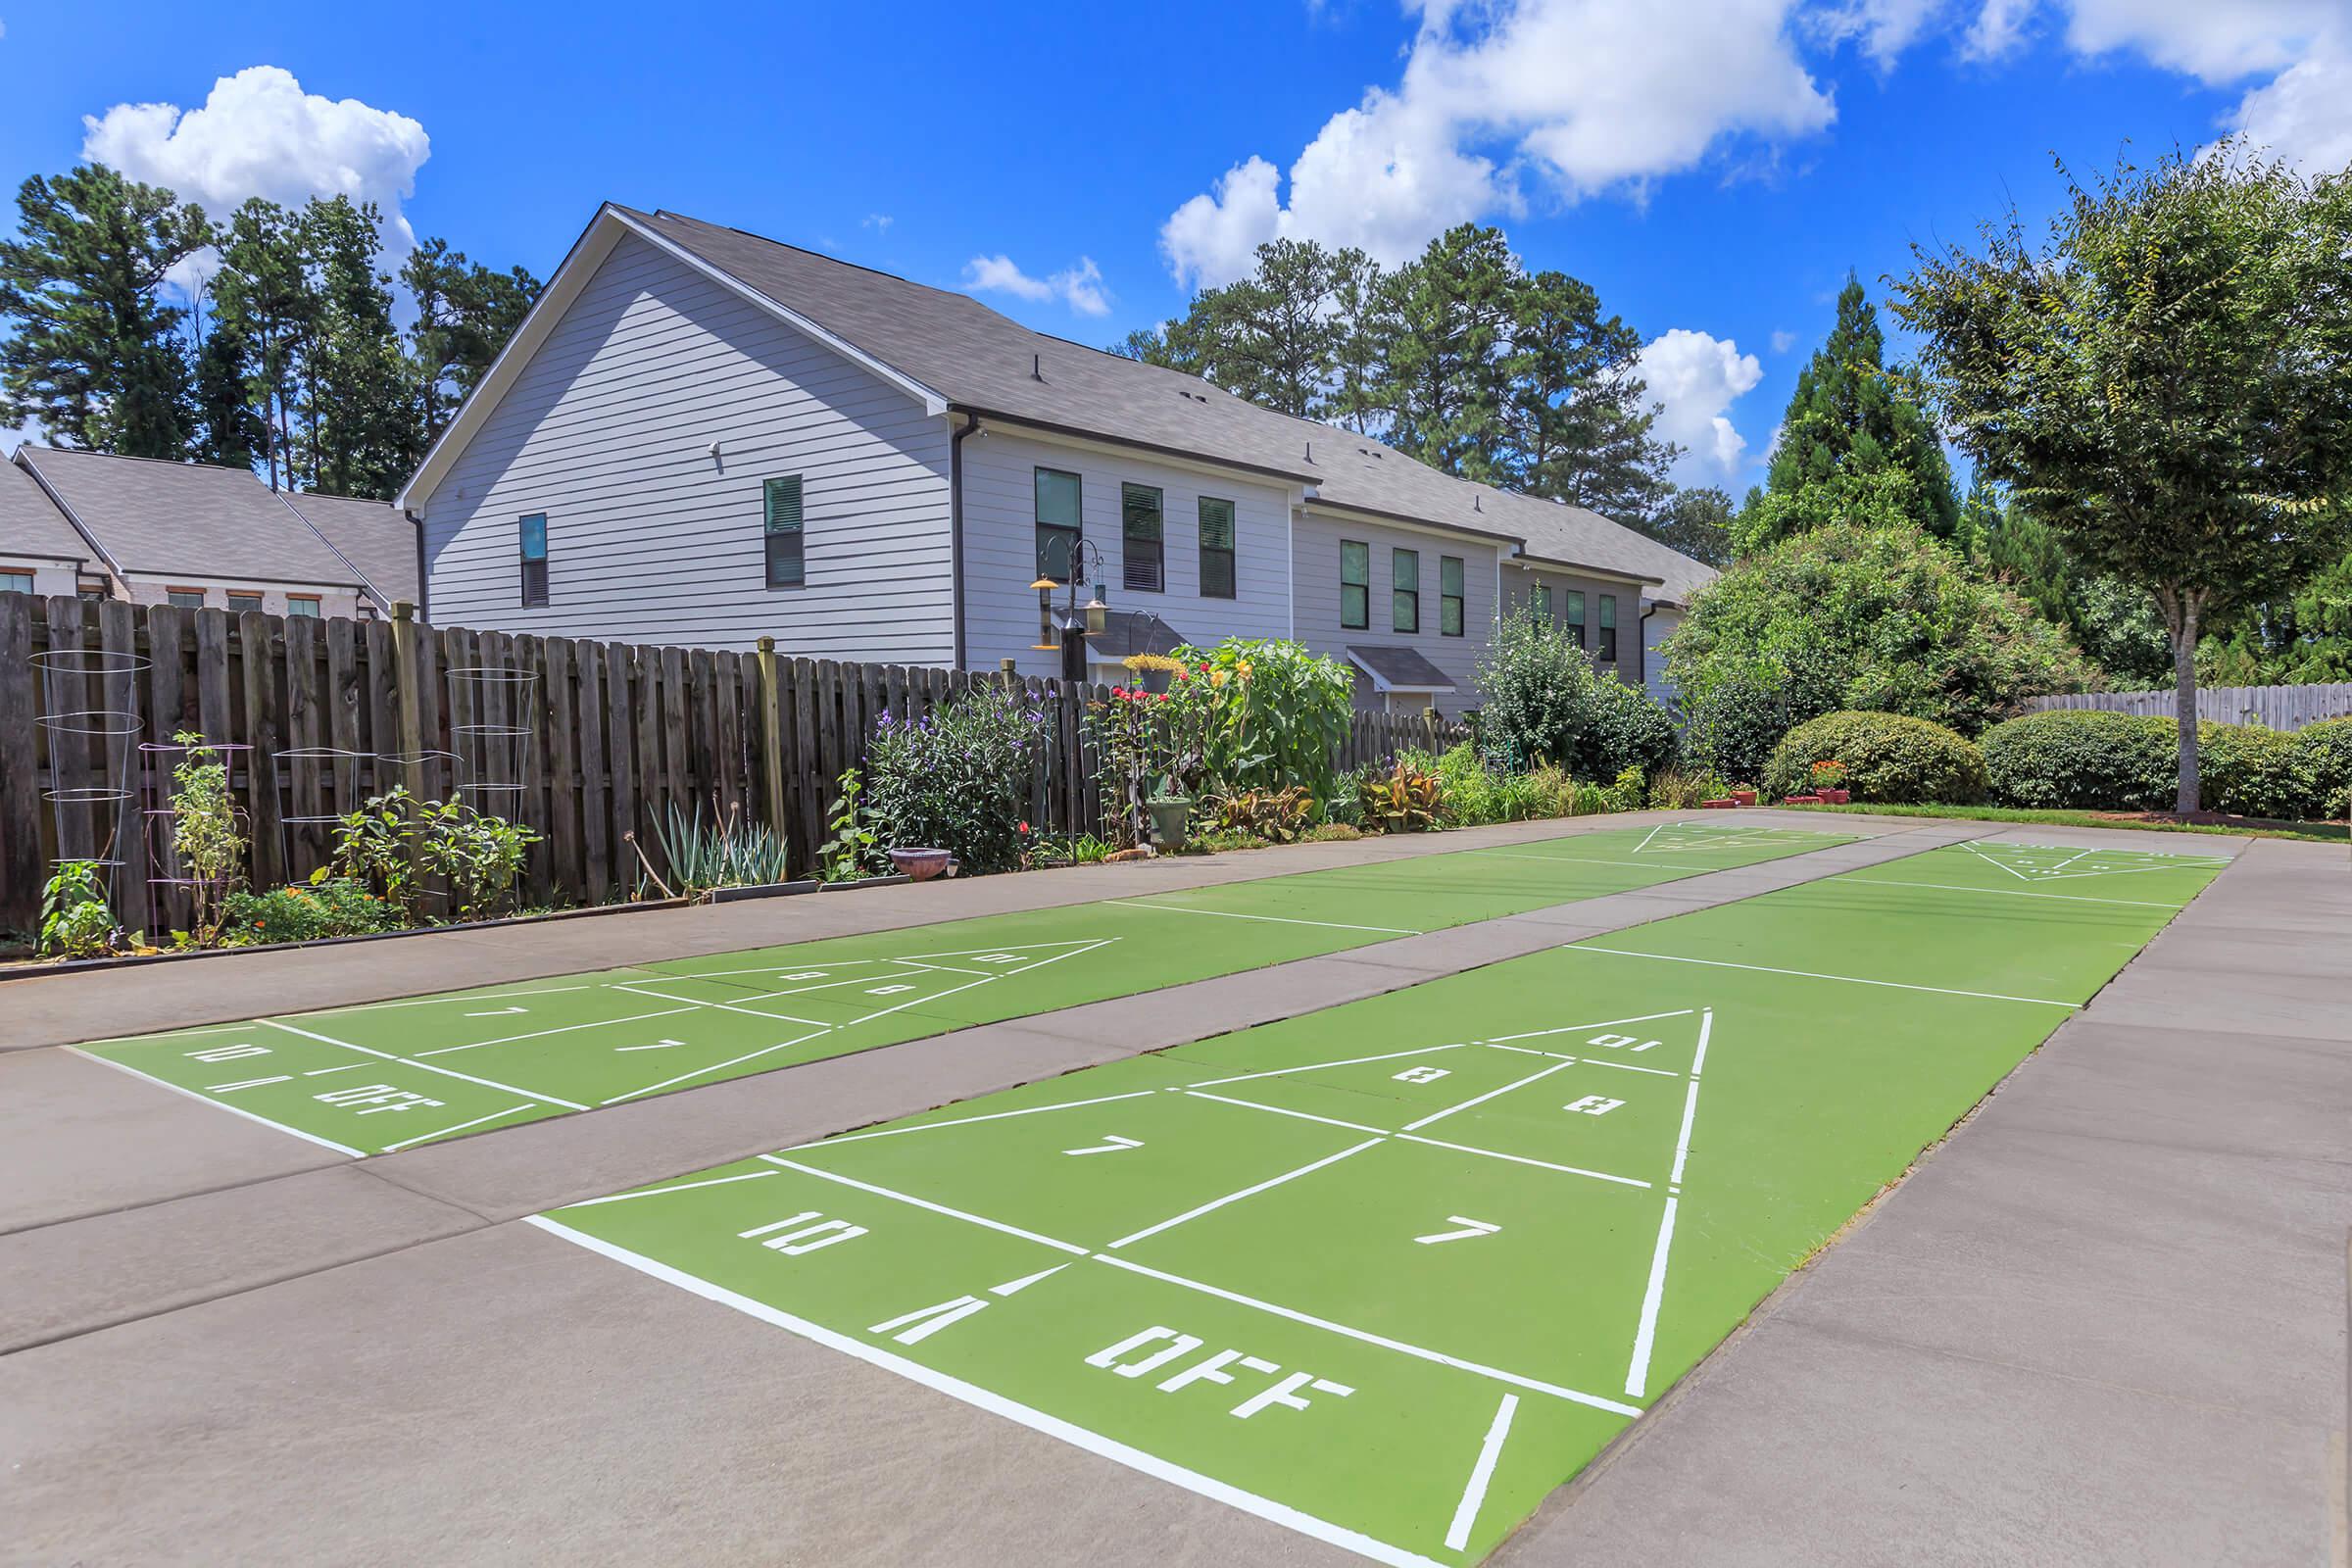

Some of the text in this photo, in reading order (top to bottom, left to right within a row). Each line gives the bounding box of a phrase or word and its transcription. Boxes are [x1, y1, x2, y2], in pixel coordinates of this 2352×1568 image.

[182, 1044, 446, 1115] 10 OFF
[1391, 1066, 1452, 1084] 8
[1562, 1095, 1627, 1116] 8
[1062, 1135, 1146, 1155] 7
[1413, 1216, 1502, 1245] 7
[737, 1211, 1356, 1419] 10 OFF
